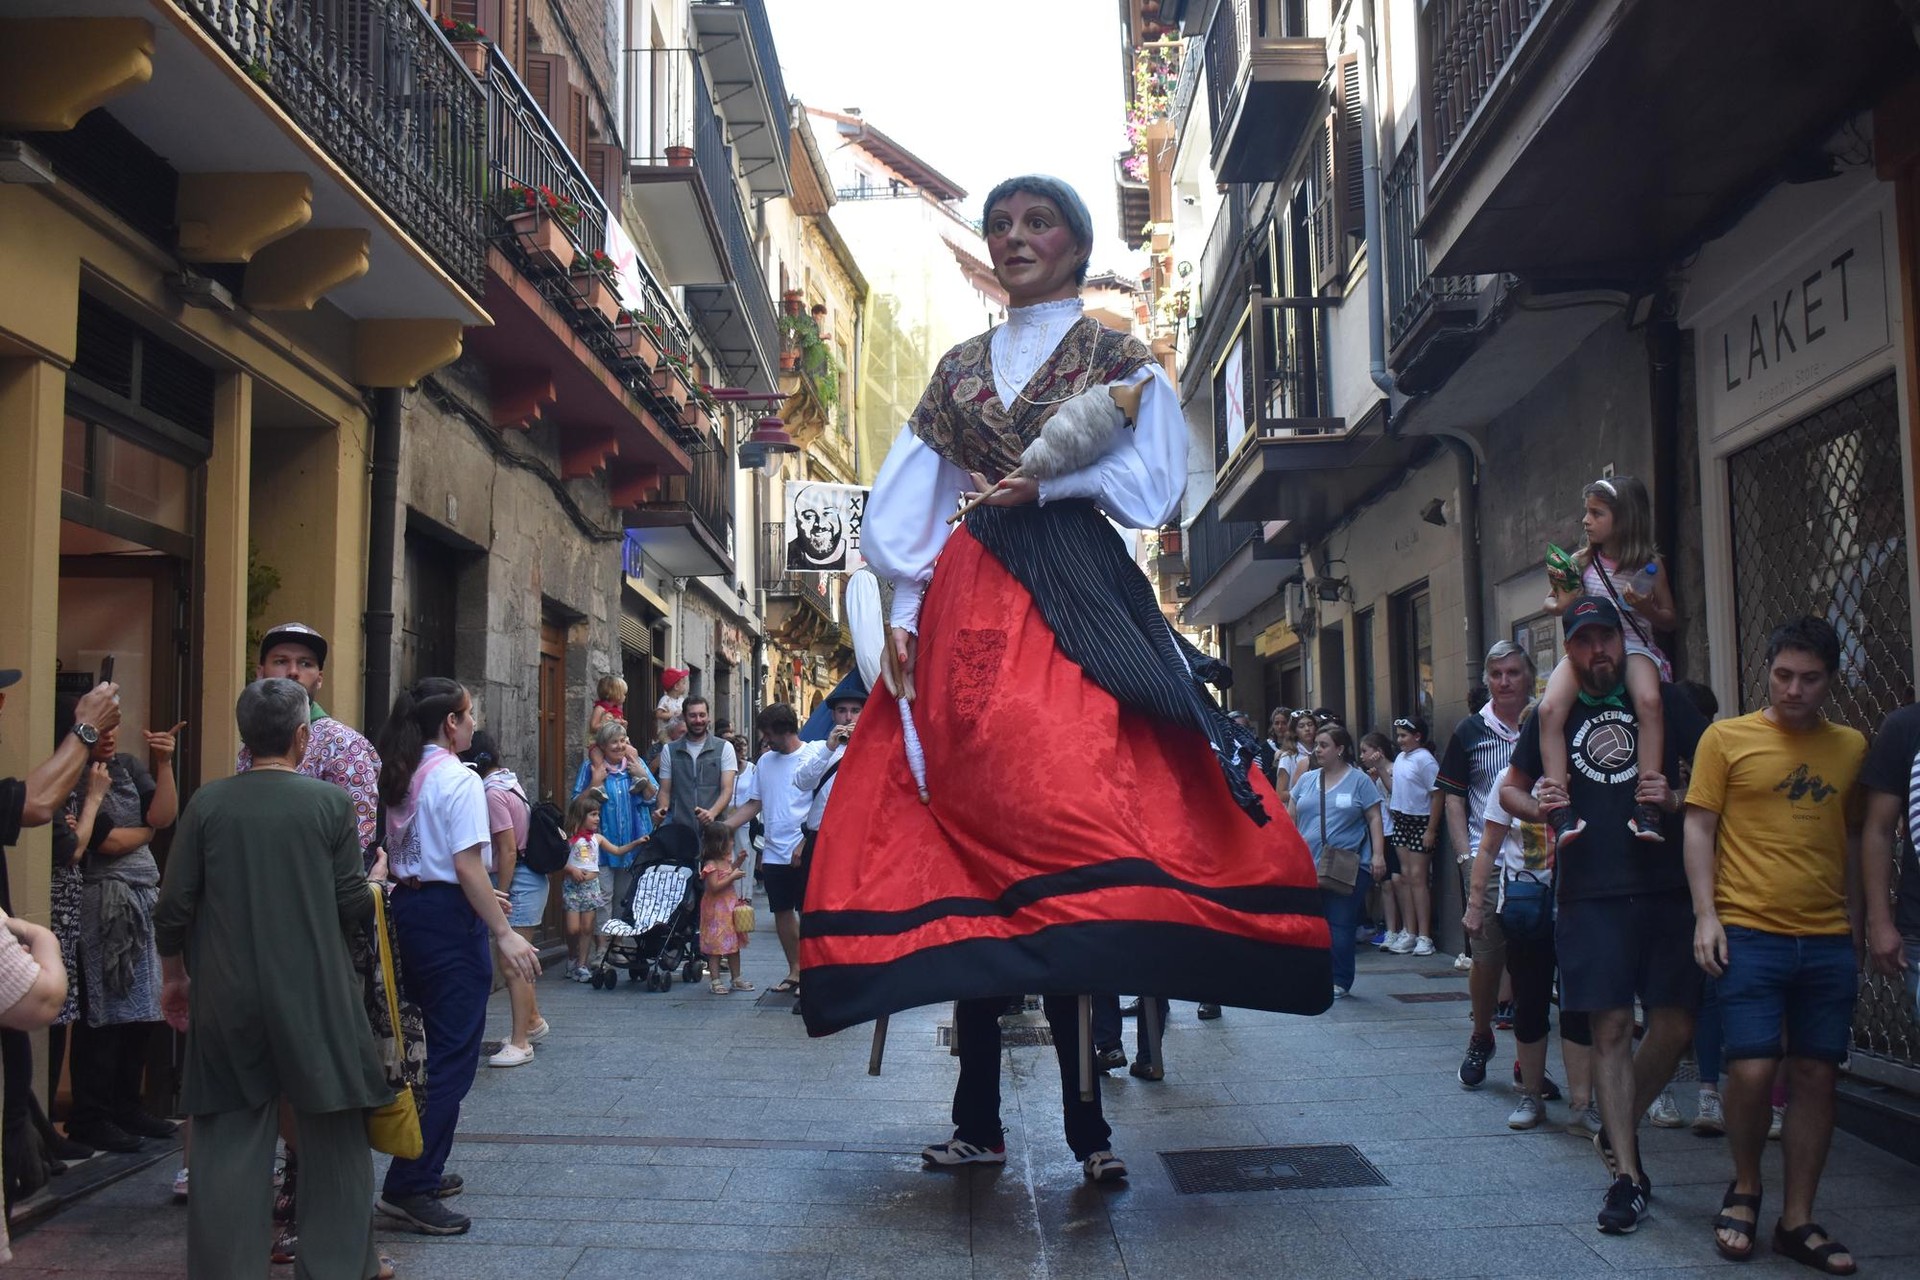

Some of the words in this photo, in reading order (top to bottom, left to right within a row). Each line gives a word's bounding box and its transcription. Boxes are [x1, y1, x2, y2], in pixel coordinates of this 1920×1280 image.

[1724, 248, 1854, 392] LAKET
[849, 498, 861, 550] XAXI
[1572, 719, 1592, 747] ODIO
[1591, 710, 1634, 724] ETERNO
